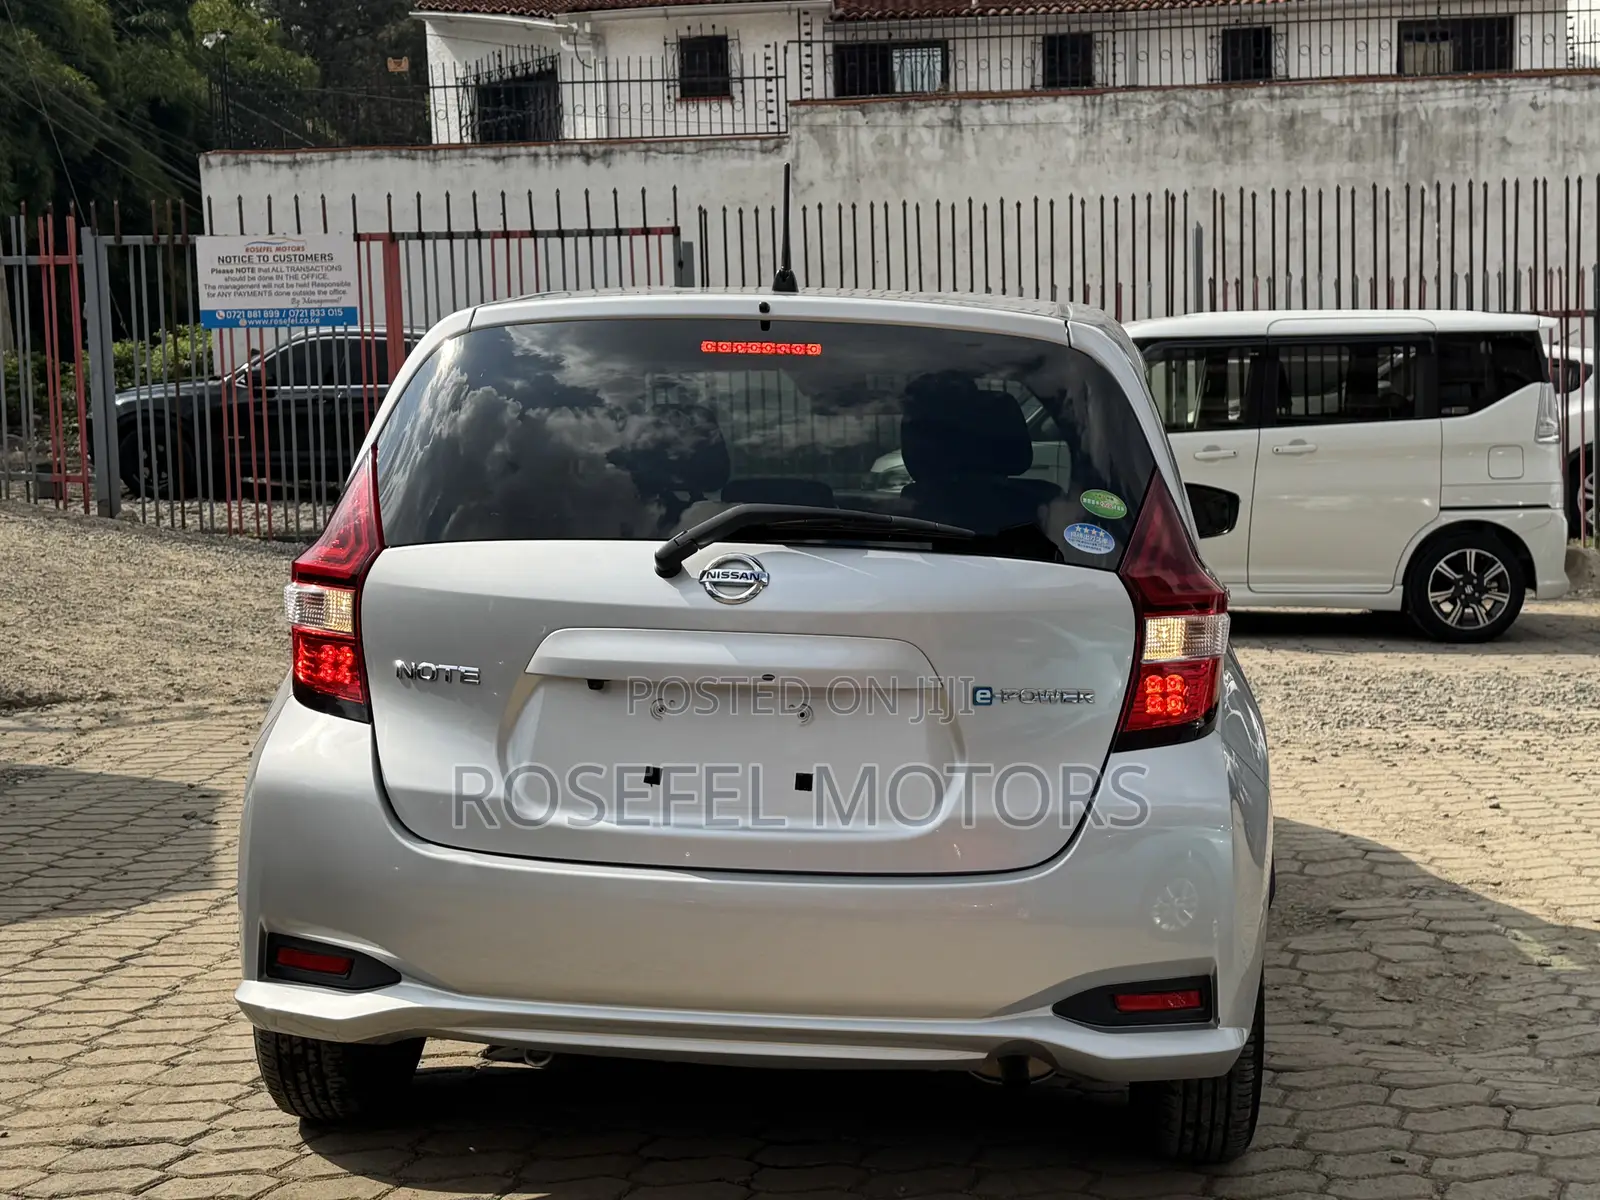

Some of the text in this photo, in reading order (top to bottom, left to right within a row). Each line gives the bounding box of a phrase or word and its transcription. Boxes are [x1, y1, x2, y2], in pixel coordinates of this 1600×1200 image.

[218, 253, 334, 264] NOTICE TO CUSTOMERS
[218, 284, 260, 292] management
[226, 310, 245, 319] 0721
[264, 310, 280, 318] 899
[288, 310, 308, 318] 0721
[310, 308, 326, 316] 833
[328, 308, 344, 316] 015
[706, 572, 760, 580] NISSAN
[395, 660, 480, 684] NOTE
